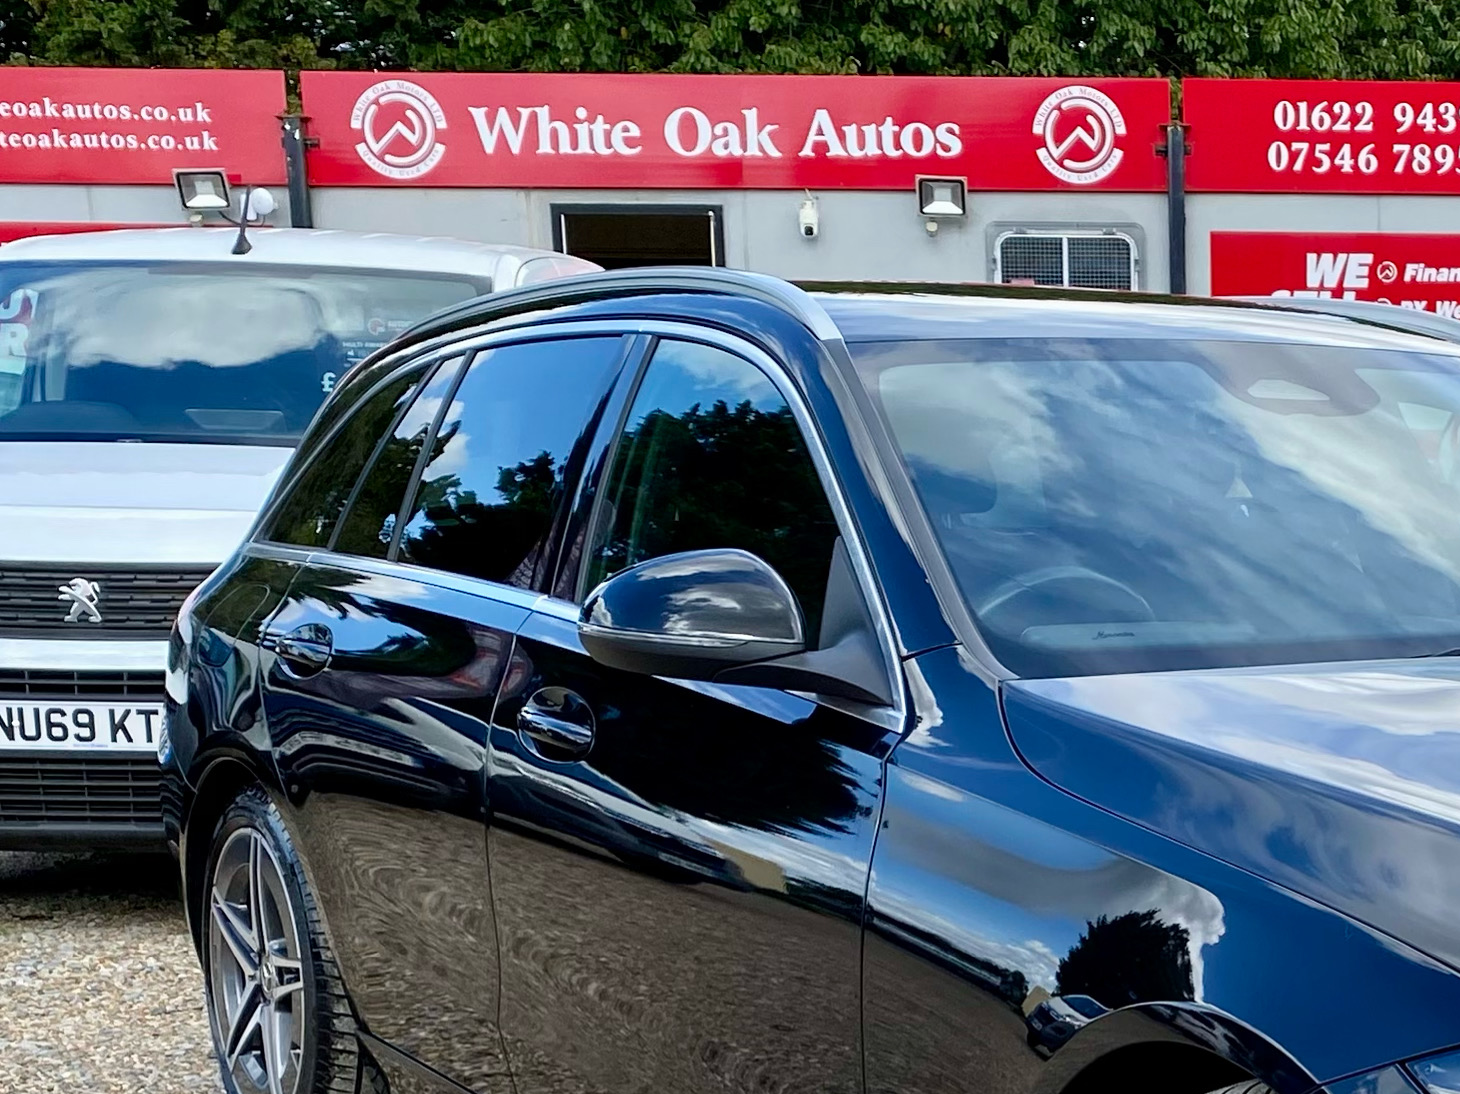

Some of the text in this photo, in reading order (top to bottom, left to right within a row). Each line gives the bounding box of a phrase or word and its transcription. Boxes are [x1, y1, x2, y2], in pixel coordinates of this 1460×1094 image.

[468, 105, 963, 158] White Oak Autos
[1273, 100, 1374, 132] 01622
[1267, 141, 1379, 174] 07546
[1306, 252, 1374, 289] WE
[0, 707, 159, 743] NU69 KT
